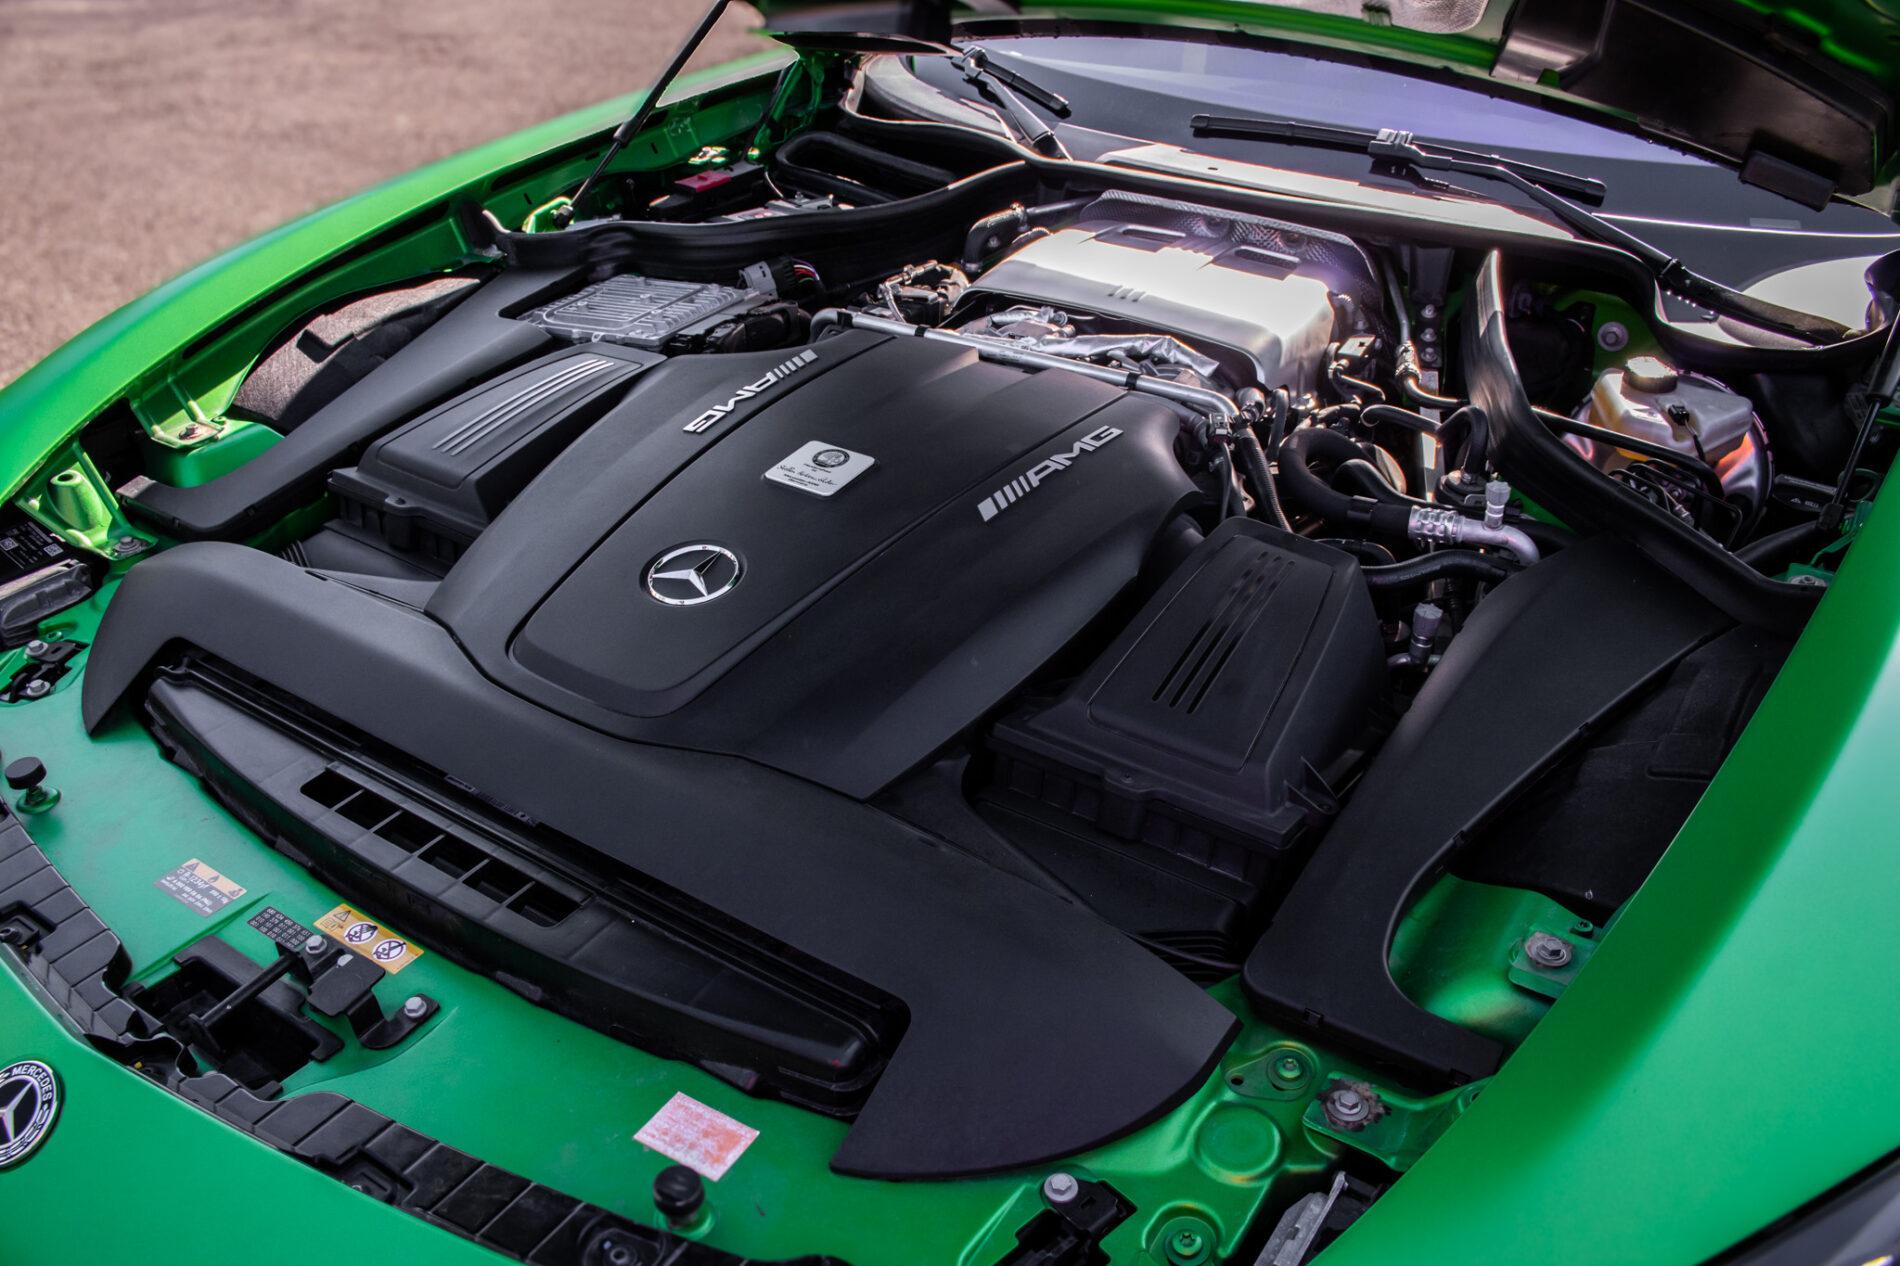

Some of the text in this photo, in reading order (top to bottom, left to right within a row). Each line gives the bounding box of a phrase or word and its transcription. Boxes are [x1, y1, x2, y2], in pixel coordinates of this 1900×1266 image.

[683, 371, 778, 433] AMG
[1026, 425, 1124, 488] AMG
[12, 1064, 53, 1101] MERCEDES
